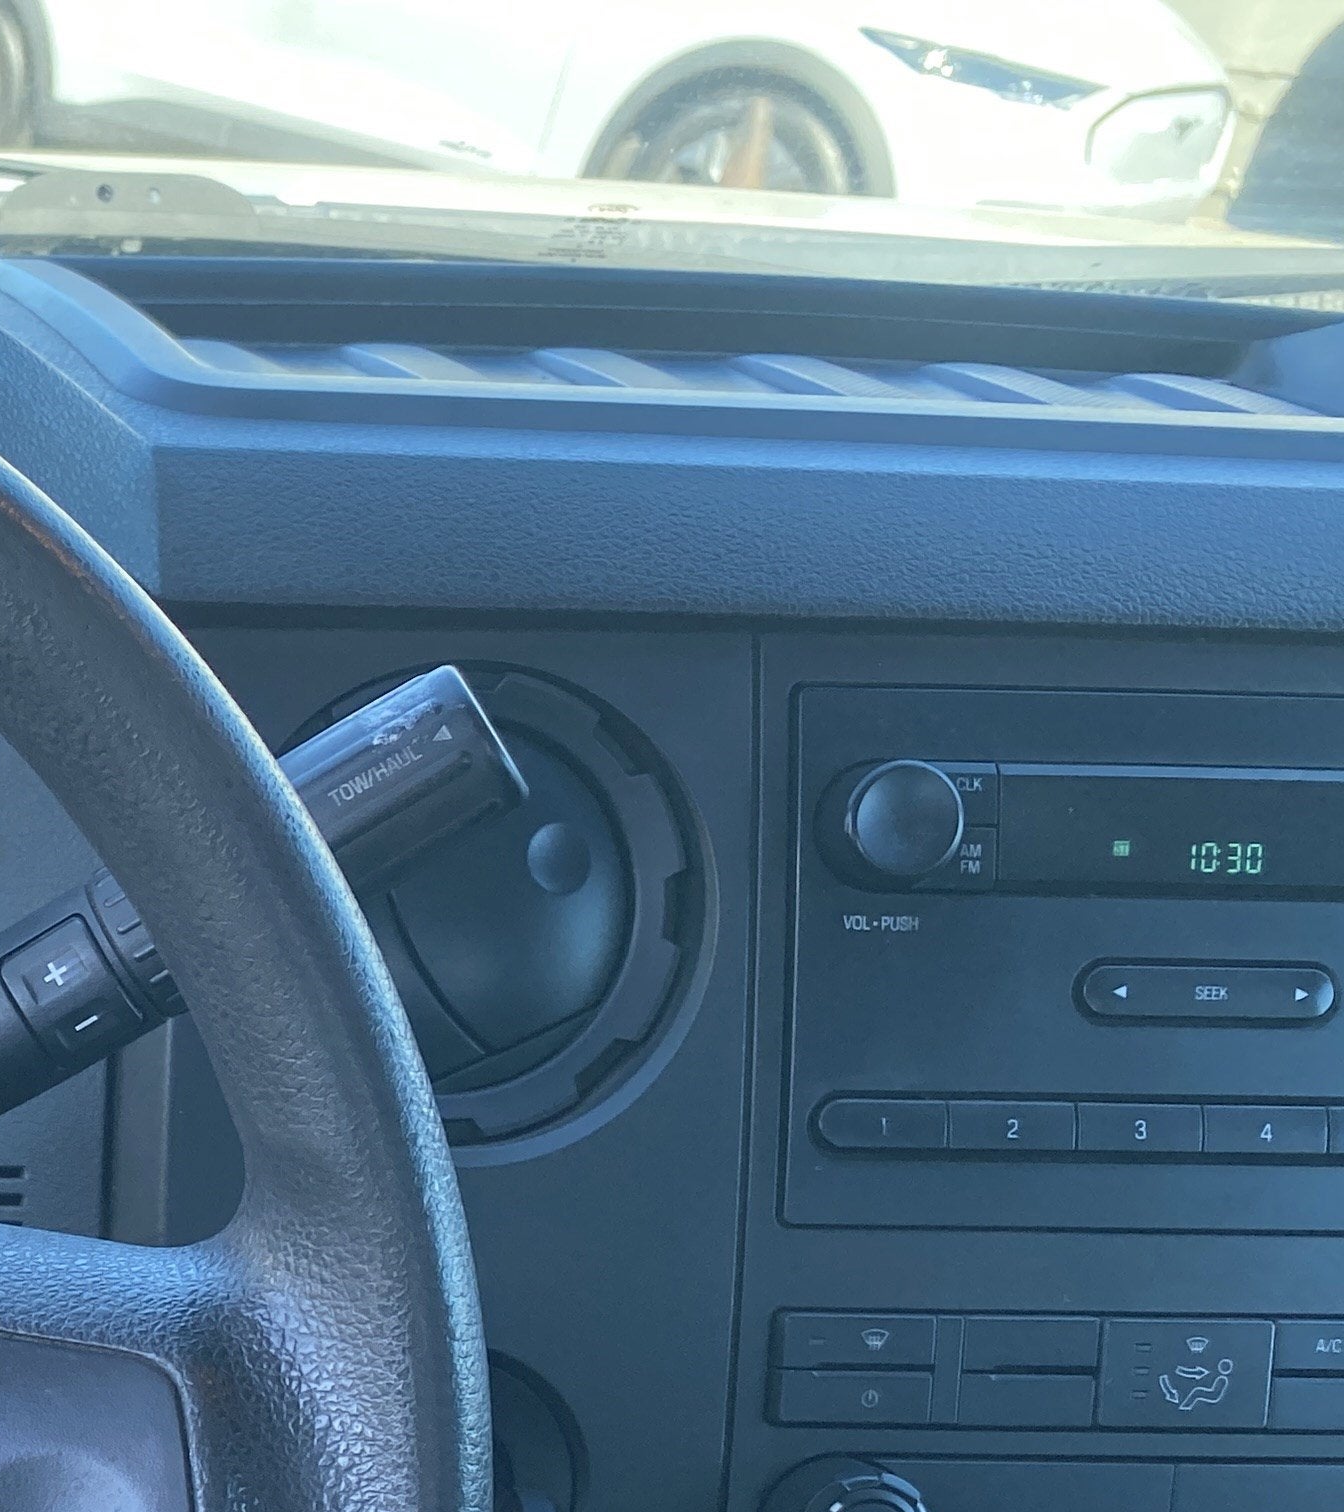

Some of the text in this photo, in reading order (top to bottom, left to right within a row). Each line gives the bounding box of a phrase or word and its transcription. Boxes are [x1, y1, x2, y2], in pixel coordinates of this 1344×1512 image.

[326, 745, 424, 809] TOW/HAUL
[955, 775, 984, 793] CLK
[959, 843, 983, 859] AM
[1189, 841, 1265, 875] 10:30
[959, 858, 982, 875] FM
[843, 914, 919, 932] VOL PUSH
[1194, 985, 1229, 1001] SEEK
[880, 1116, 889, 1136] 1
[1006, 1118, 1021, 1140] 2
[1133, 1119, 1148, 1141] 3
[1258, 1122, 1274, 1143] 4
[1315, 1336, 1343, 1355] A/C
